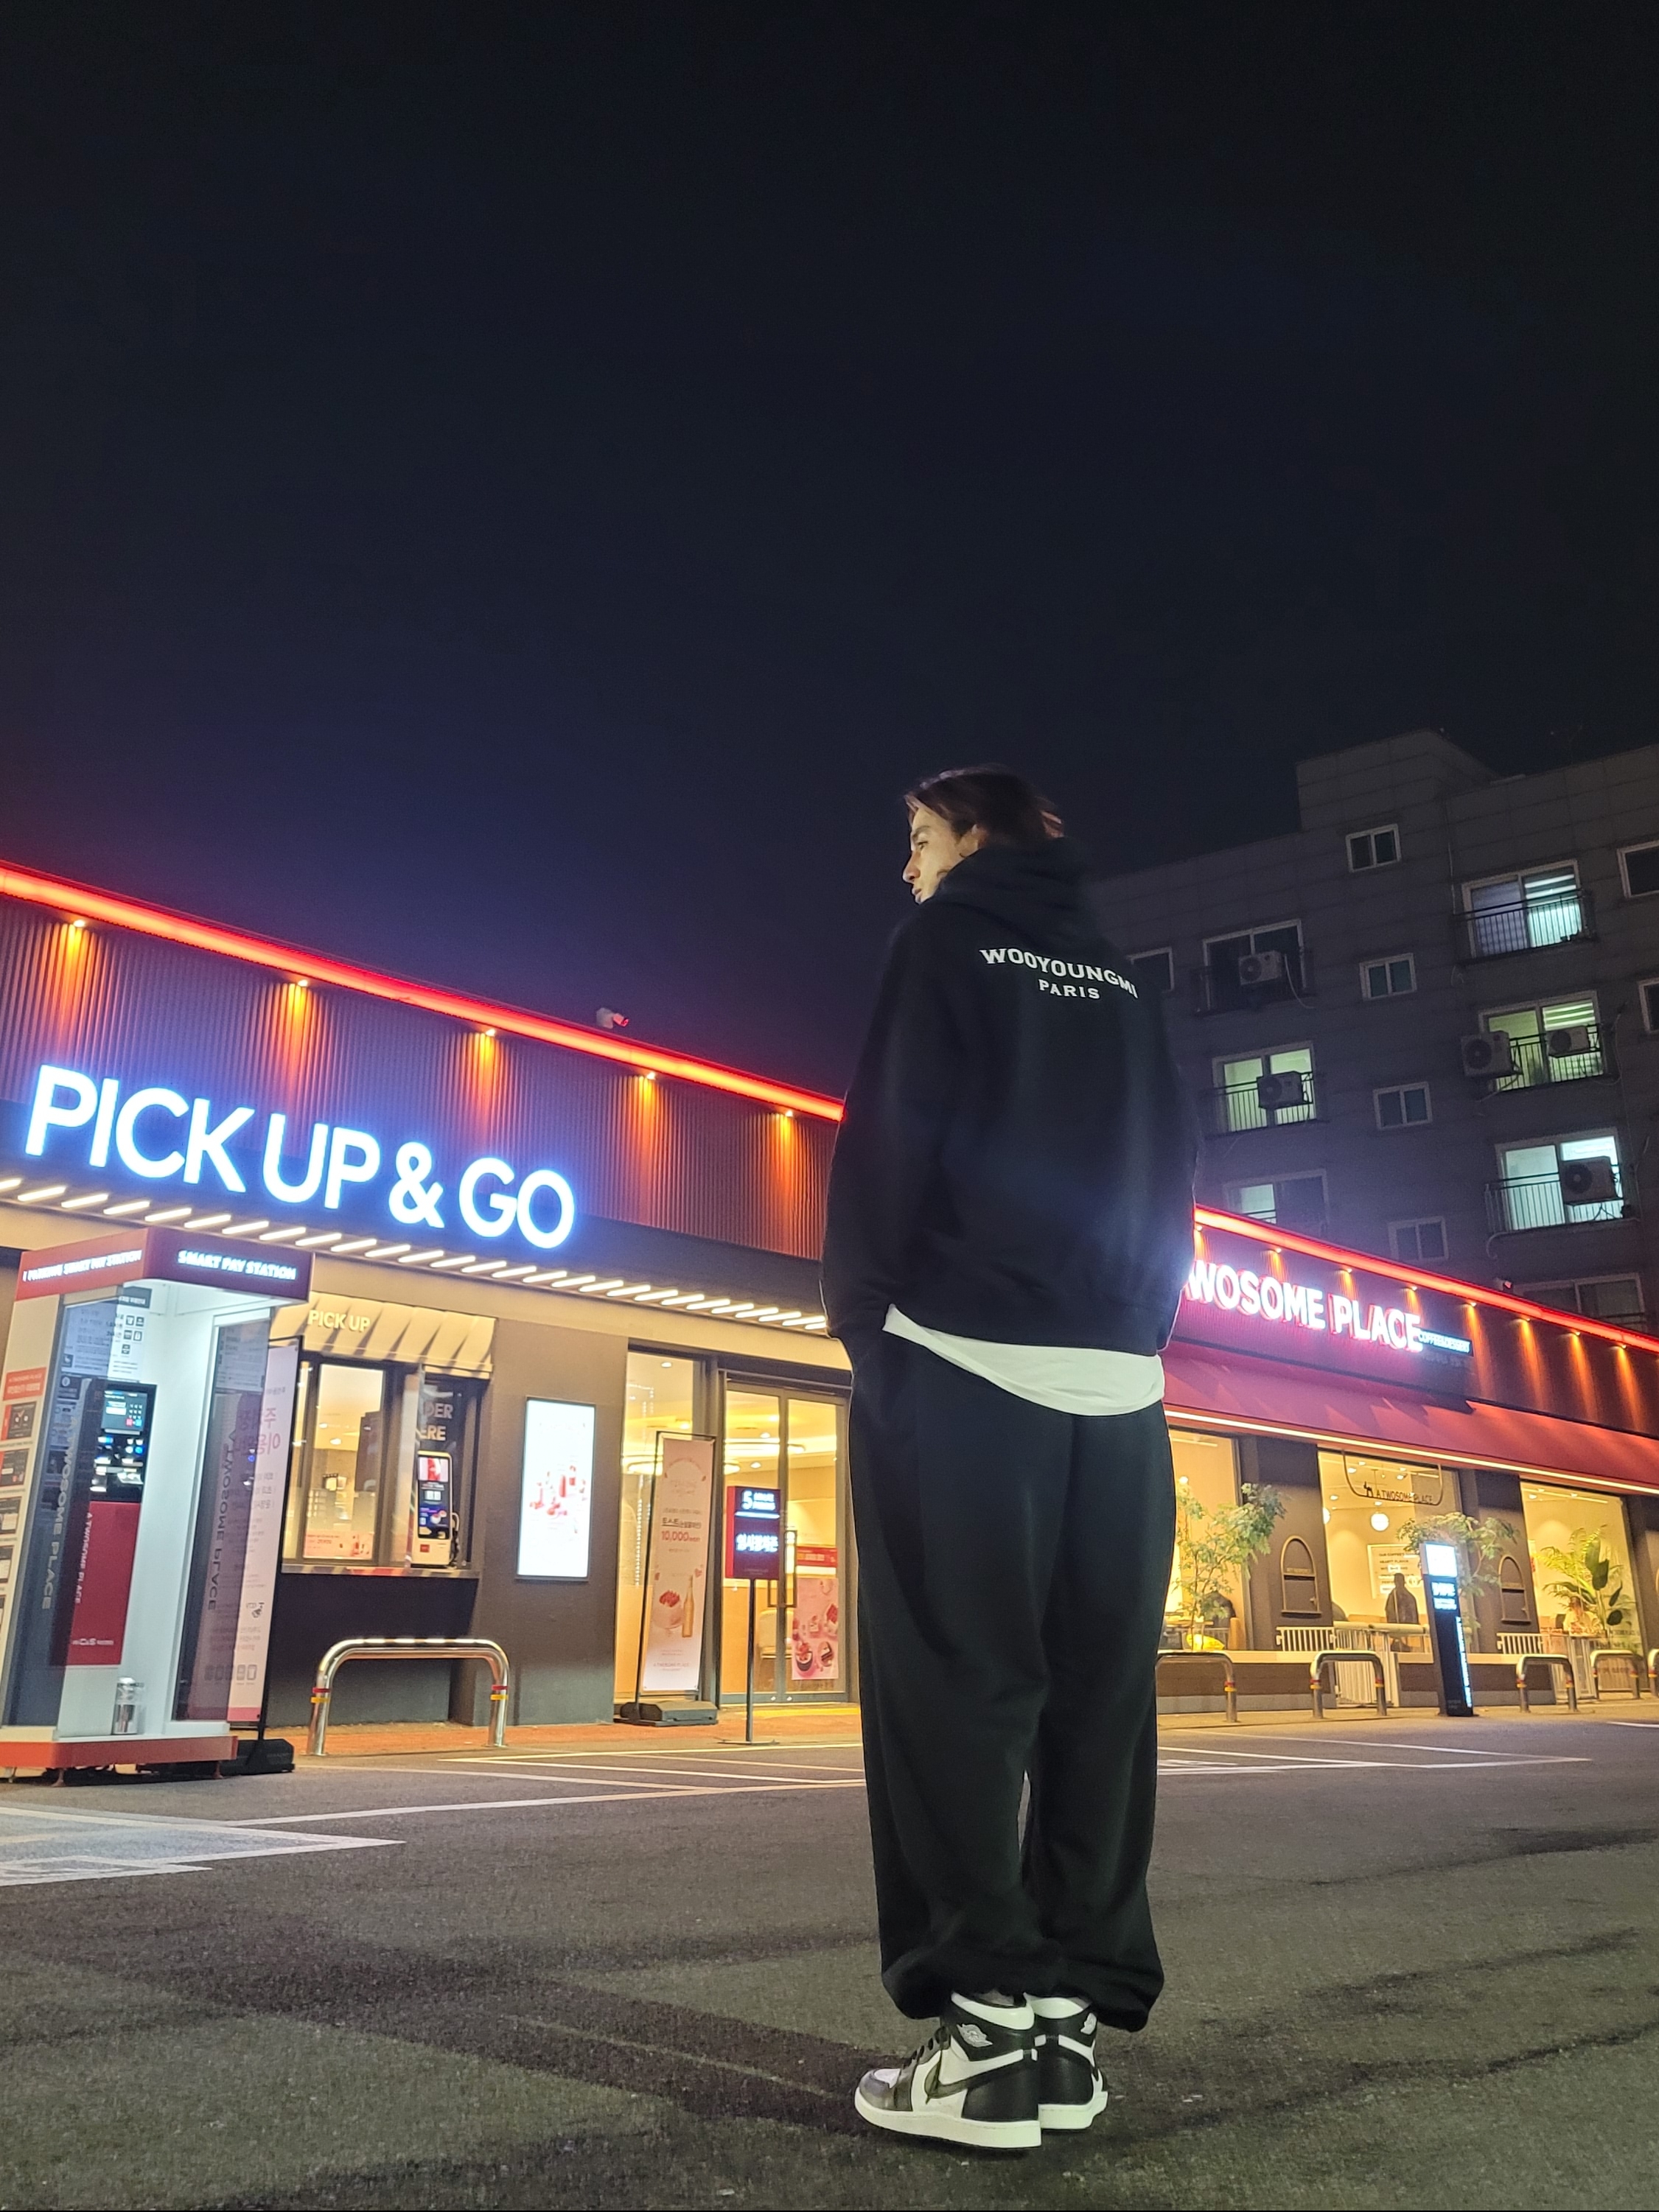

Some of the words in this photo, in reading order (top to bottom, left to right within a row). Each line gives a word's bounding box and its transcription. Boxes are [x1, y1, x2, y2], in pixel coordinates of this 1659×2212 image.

[979, 948, 1138, 998] WOOYOUNGMI
[1038, 979, 1100, 999] PARIS
[25, 1065, 255, 1193] PICK
[263, 1113, 380, 1209] UP
[388, 1141, 444, 1228] &
[459, 1158, 574, 1248] GO
[178, 1250, 222, 1268] SMART
[222, 1257, 246, 1273] PAY
[245, 1261, 296, 1280] STATION
[308, 1310, 346, 1329] PICK
[349, 1315, 371, 1332] UP
[1328, 1293, 1423, 1352] PLACE
[42, 1542, 60, 1609] PLACE
